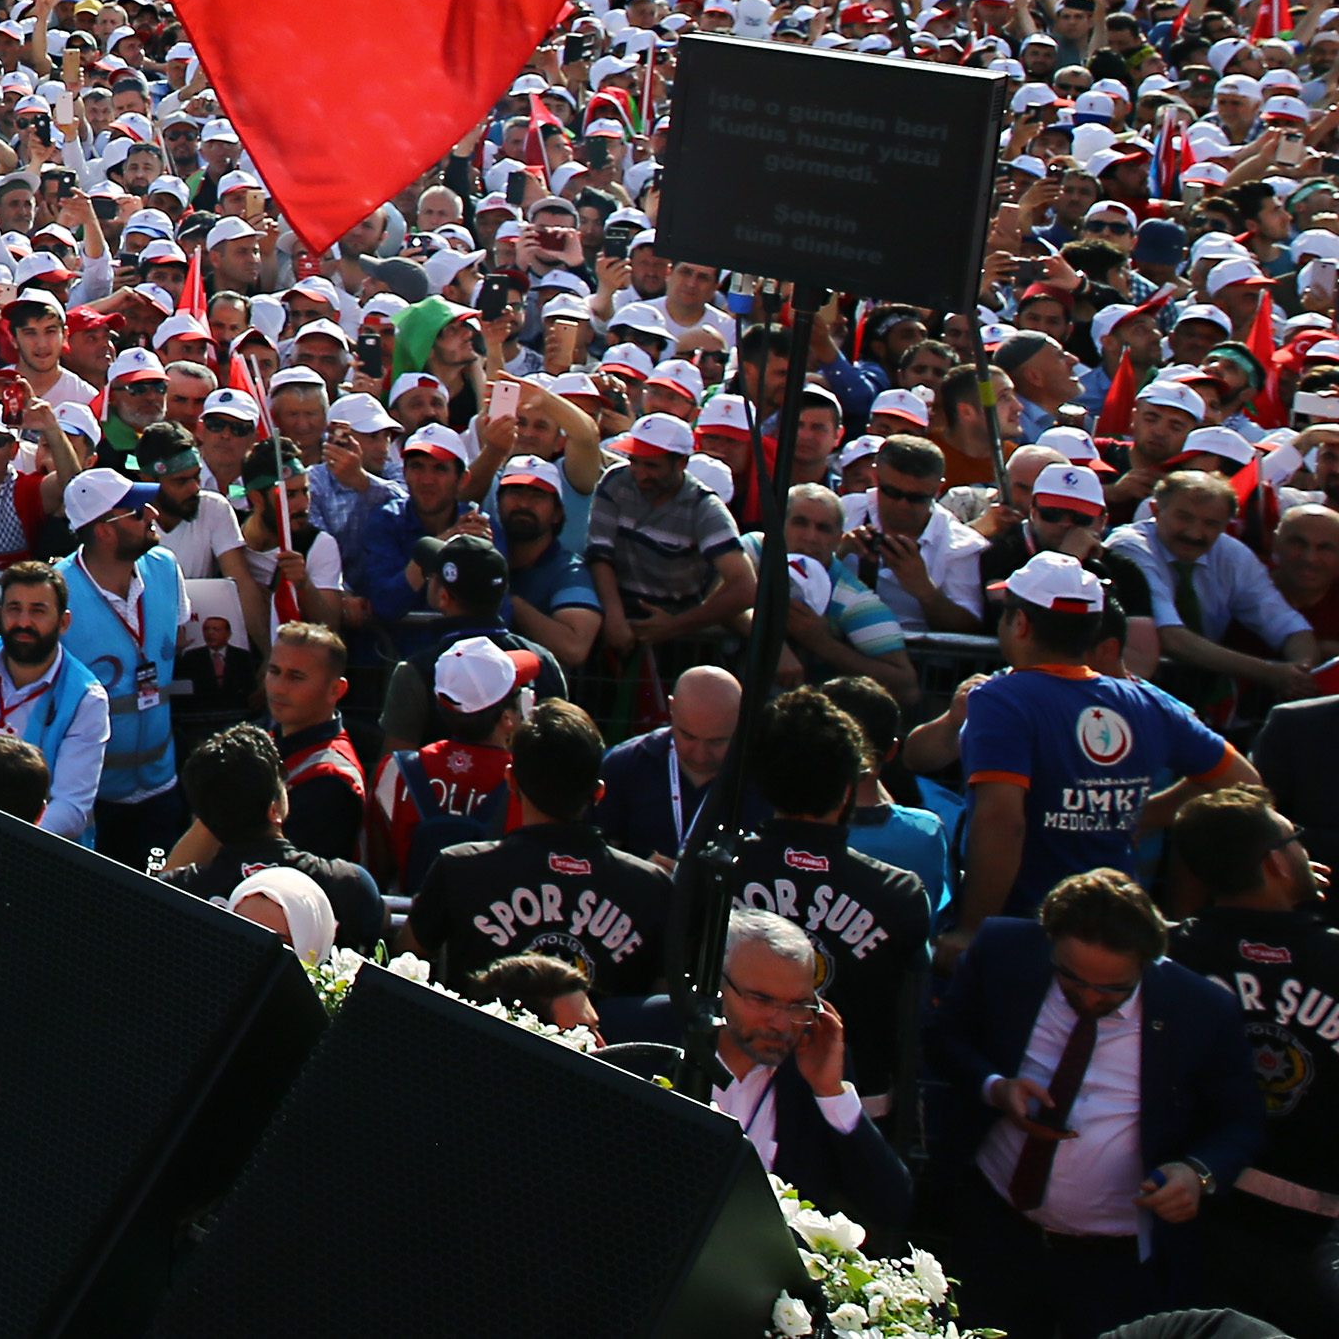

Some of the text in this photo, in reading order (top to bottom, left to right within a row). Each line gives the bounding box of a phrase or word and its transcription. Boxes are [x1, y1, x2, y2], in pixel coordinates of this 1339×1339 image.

[708, 89, 949, 141] İşte o günden beri
[708, 116, 940, 168] Kudüs huzur yüzü
[765, 152, 879, 184] görmedi.
[773, 203, 858, 233] Şehrin
[734, 223, 884, 265] tüm dinlere
[791, 855, 825, 868] İSTANBUL
[473, 883, 644, 964] SPOR ŞUBE
[805, 884, 889, 960] ŞUBE
